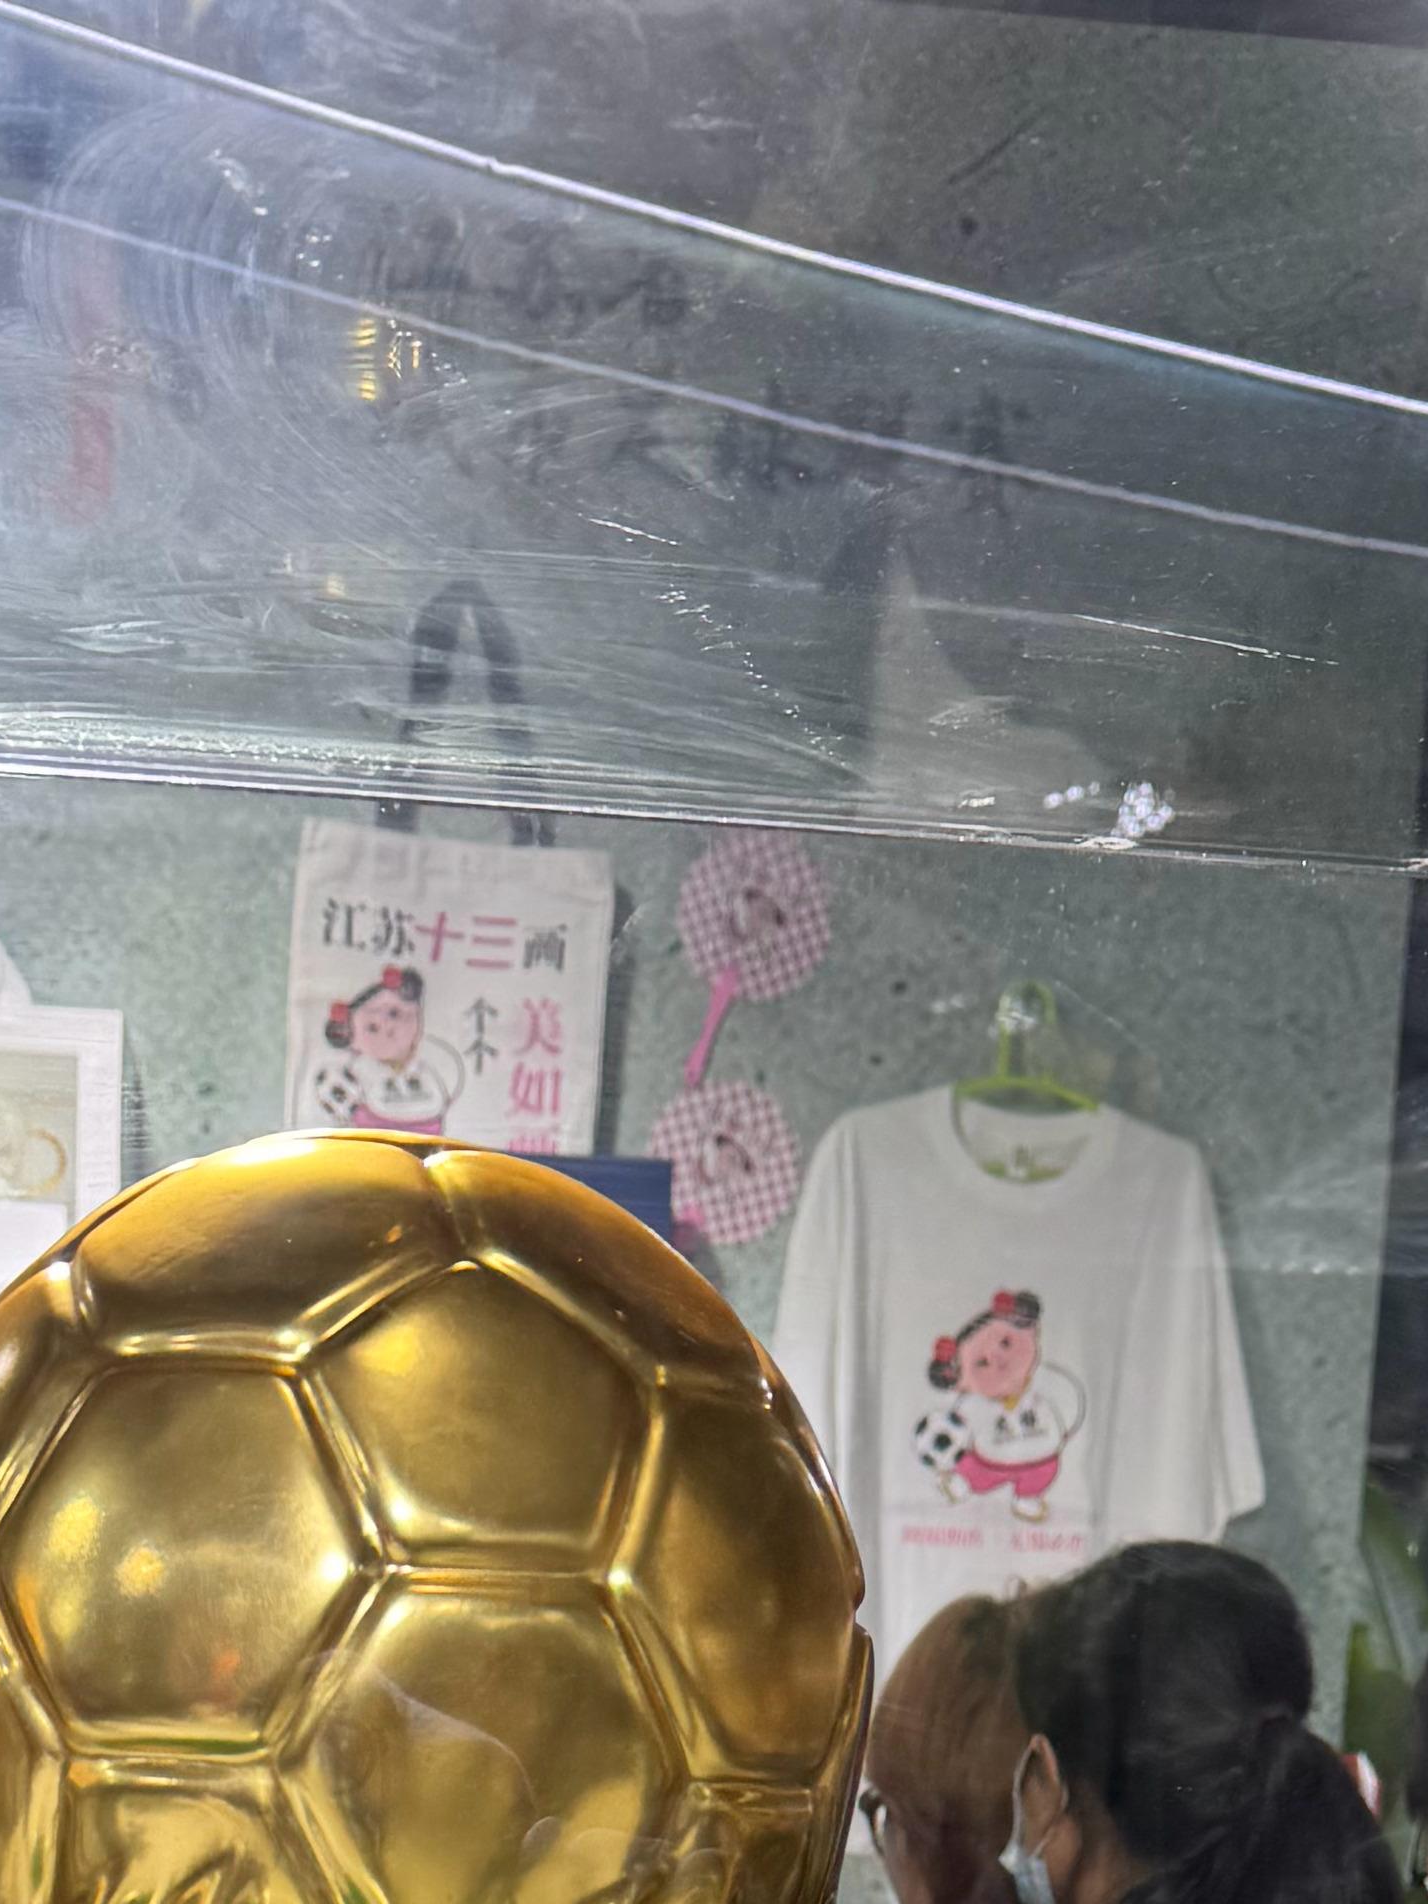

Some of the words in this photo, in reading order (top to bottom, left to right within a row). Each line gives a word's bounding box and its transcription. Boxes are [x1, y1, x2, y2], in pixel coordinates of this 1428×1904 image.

[321, 897, 568, 973] 江苏十三画
